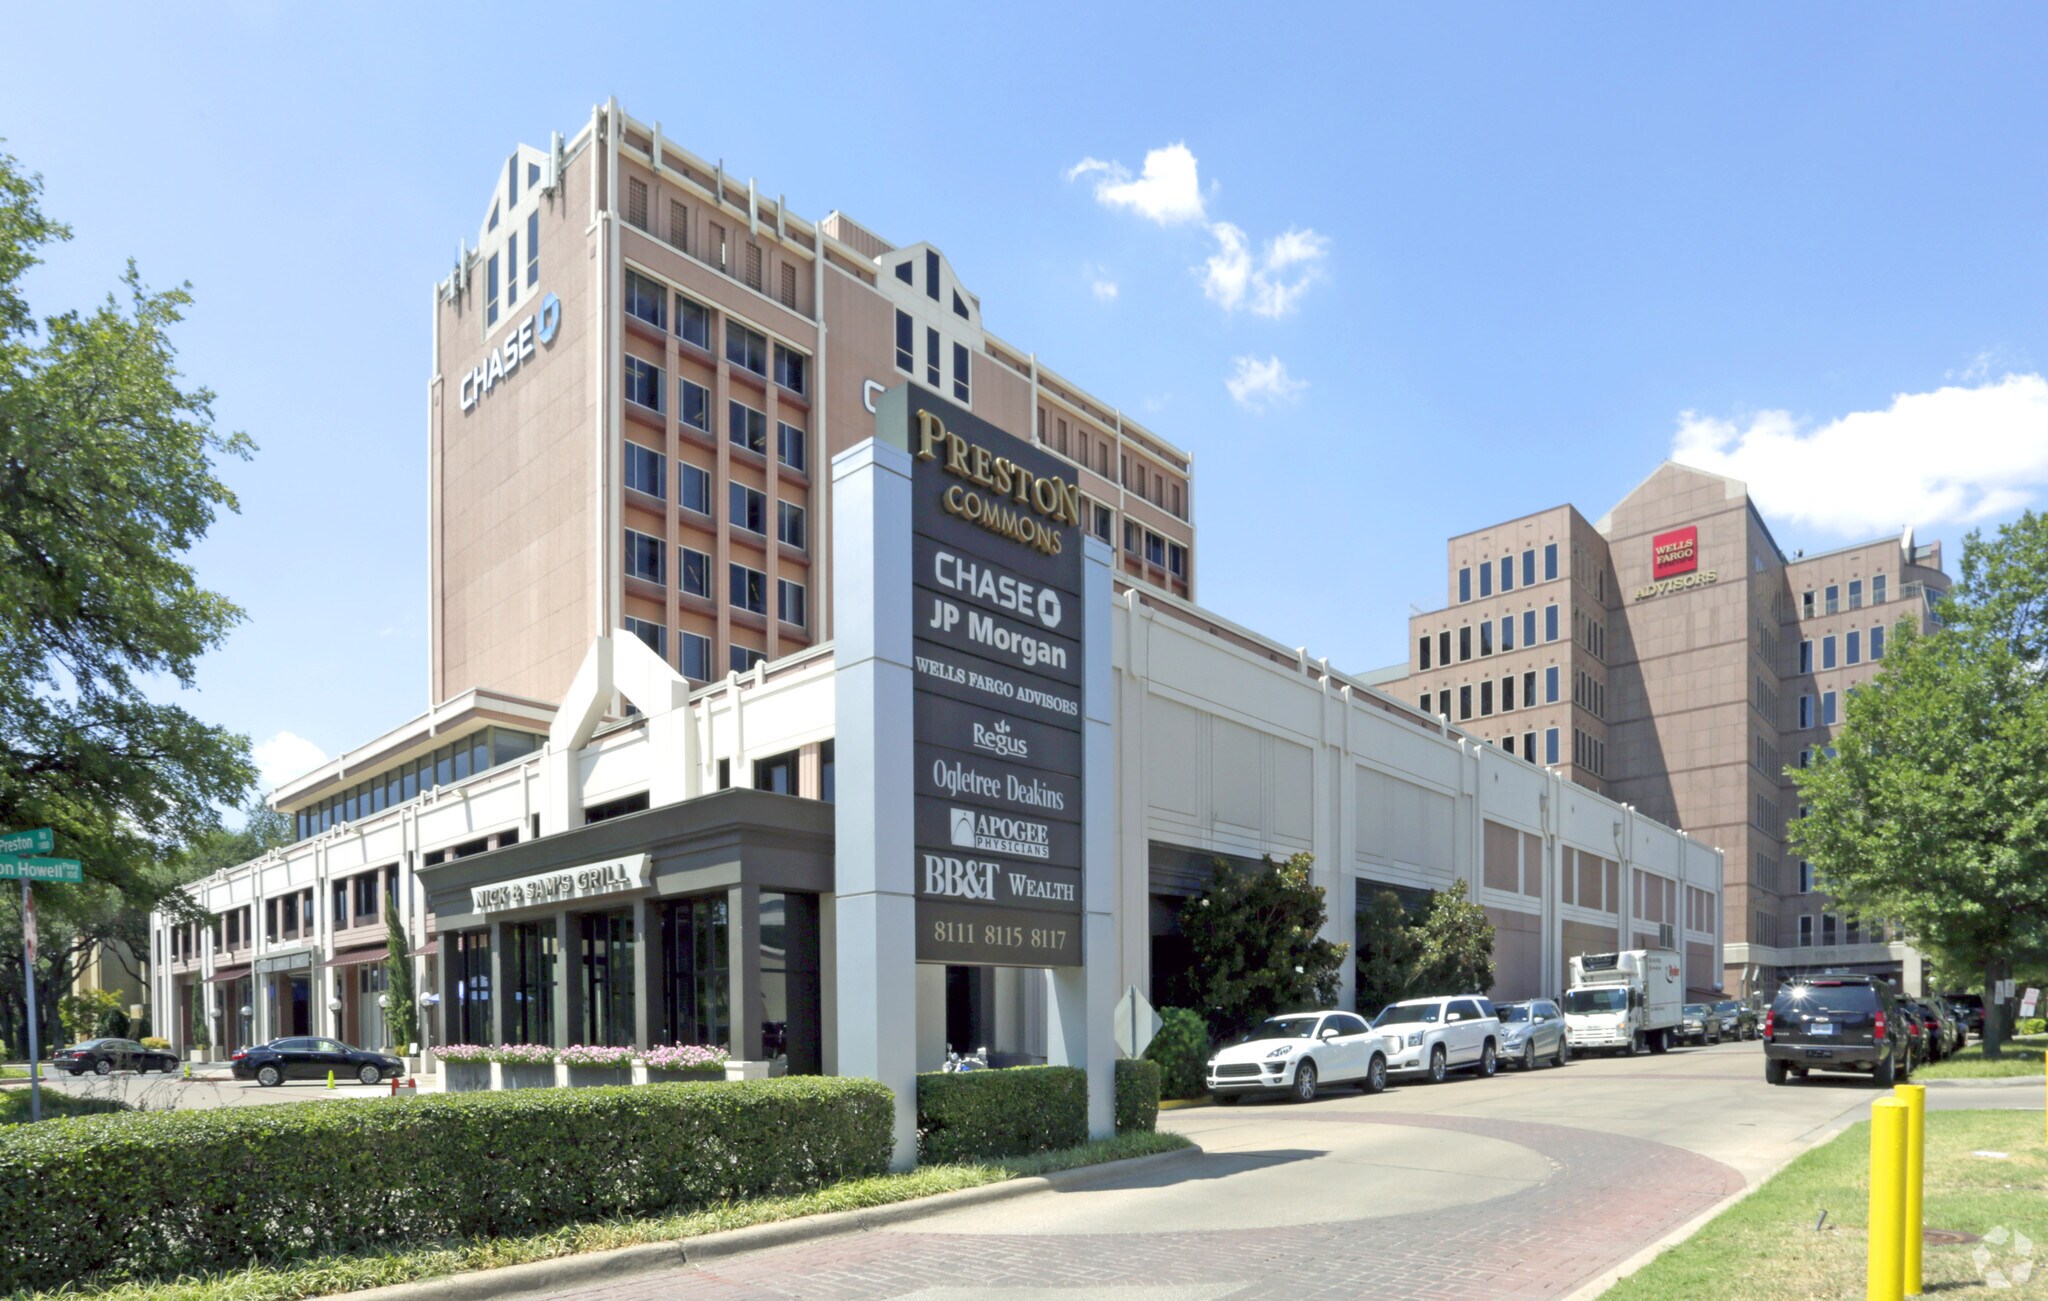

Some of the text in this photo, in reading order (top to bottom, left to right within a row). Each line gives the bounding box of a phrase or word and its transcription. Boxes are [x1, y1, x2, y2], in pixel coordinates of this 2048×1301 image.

[459, 314, 535, 411] CHASE
[917, 408, 1079, 526] PRESTON
[943, 485, 1062, 555] COMMONS
[1655, 539, 1694, 555] WELLS
[1656, 548, 1694, 565] FARGO
[935, 551, 1035, 617] CHASE
[1634, 569, 1718, 601] ADVISORS
[930, 599, 1067, 669] JP Morgan
[915, 655, 1078, 716] WELLS FARGO ADVISORS
[973, 721, 1028, 756] Regus
[933, 759, 1064, 811] Ogletree Deakins
[0, 837, 33, 852] Preston
[975, 814, 1049, 845] APOGEE
[976, 836, 1049, 857] PHYSICIANS
[18, 861, 62, 878] Howell
[475, 863, 631, 908] NICK & SAM'S GRILL
[922, 854, 1075, 901] BB&T WEALTH
[934, 920, 1067, 950] 8111 8115 8117
